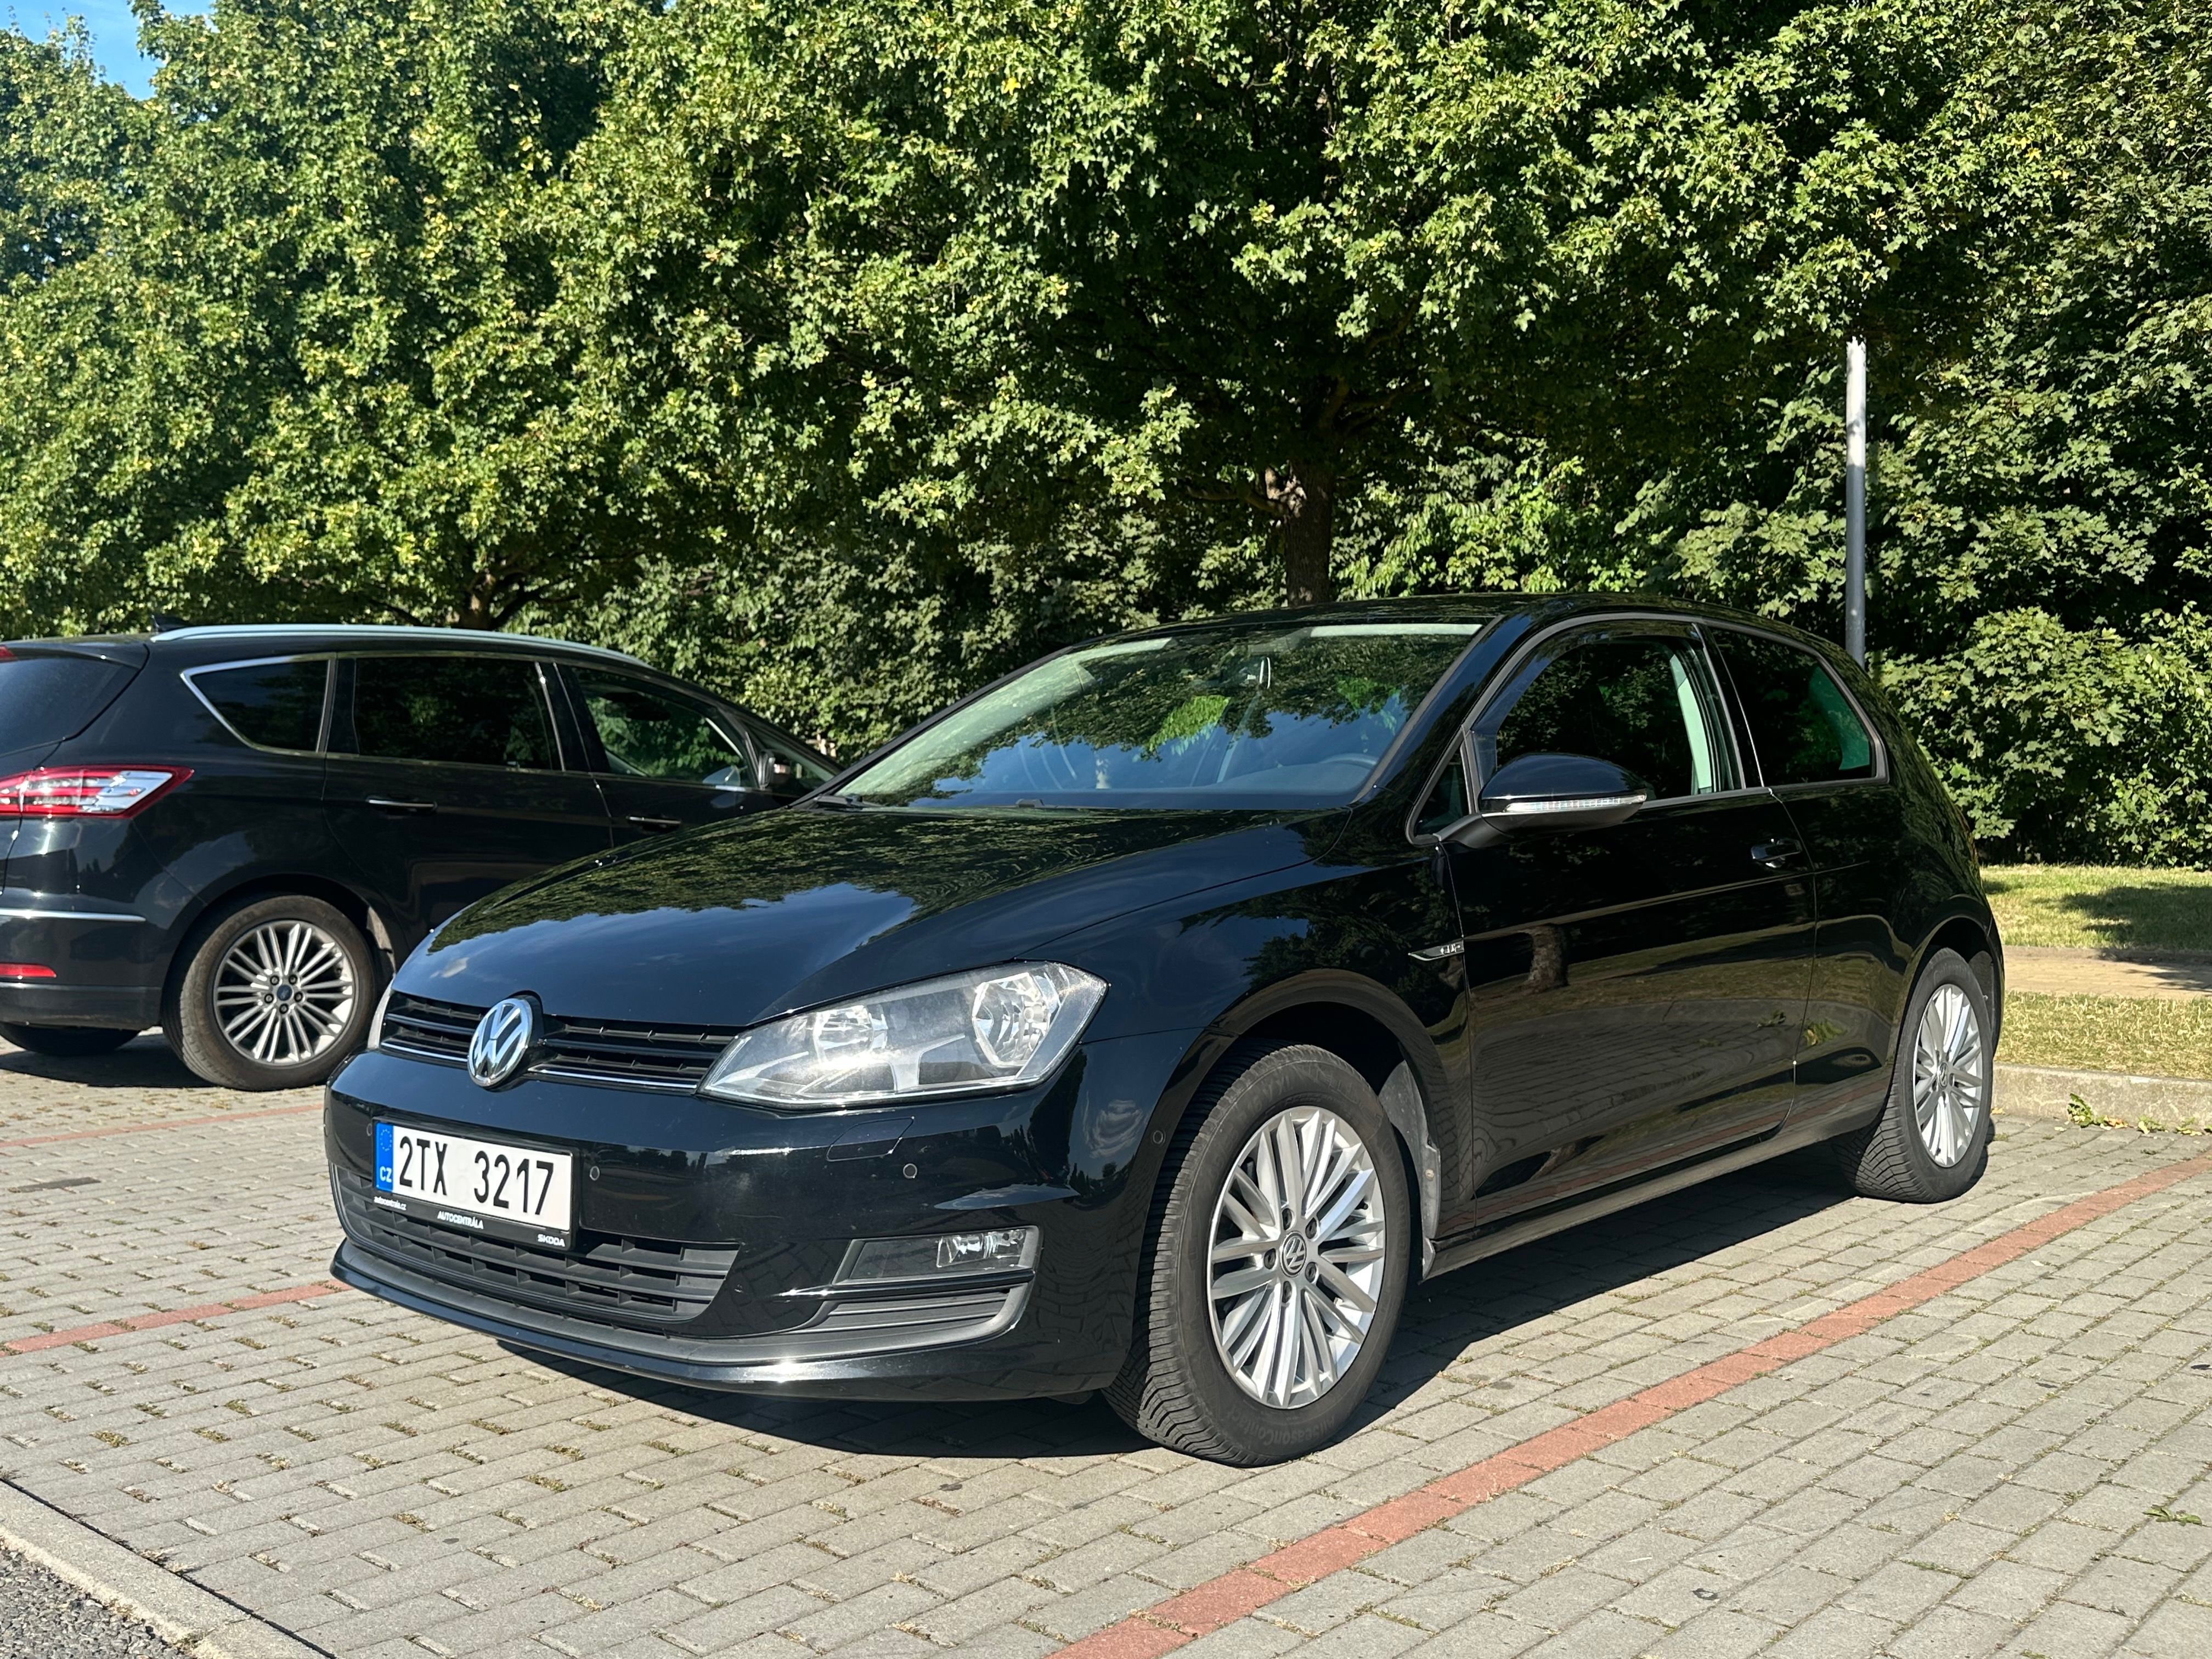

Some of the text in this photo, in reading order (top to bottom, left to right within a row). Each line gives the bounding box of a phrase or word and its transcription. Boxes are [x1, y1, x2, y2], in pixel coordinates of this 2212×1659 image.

[469, 1000, 529, 1084] VW
[379, 1166, 392, 1183] CZ
[399, 1136, 554, 1215] 2TX 3217
[437, 1211, 484, 1229] AUTOCENTRÁLA
[1283, 1234, 1306, 1275] VW
